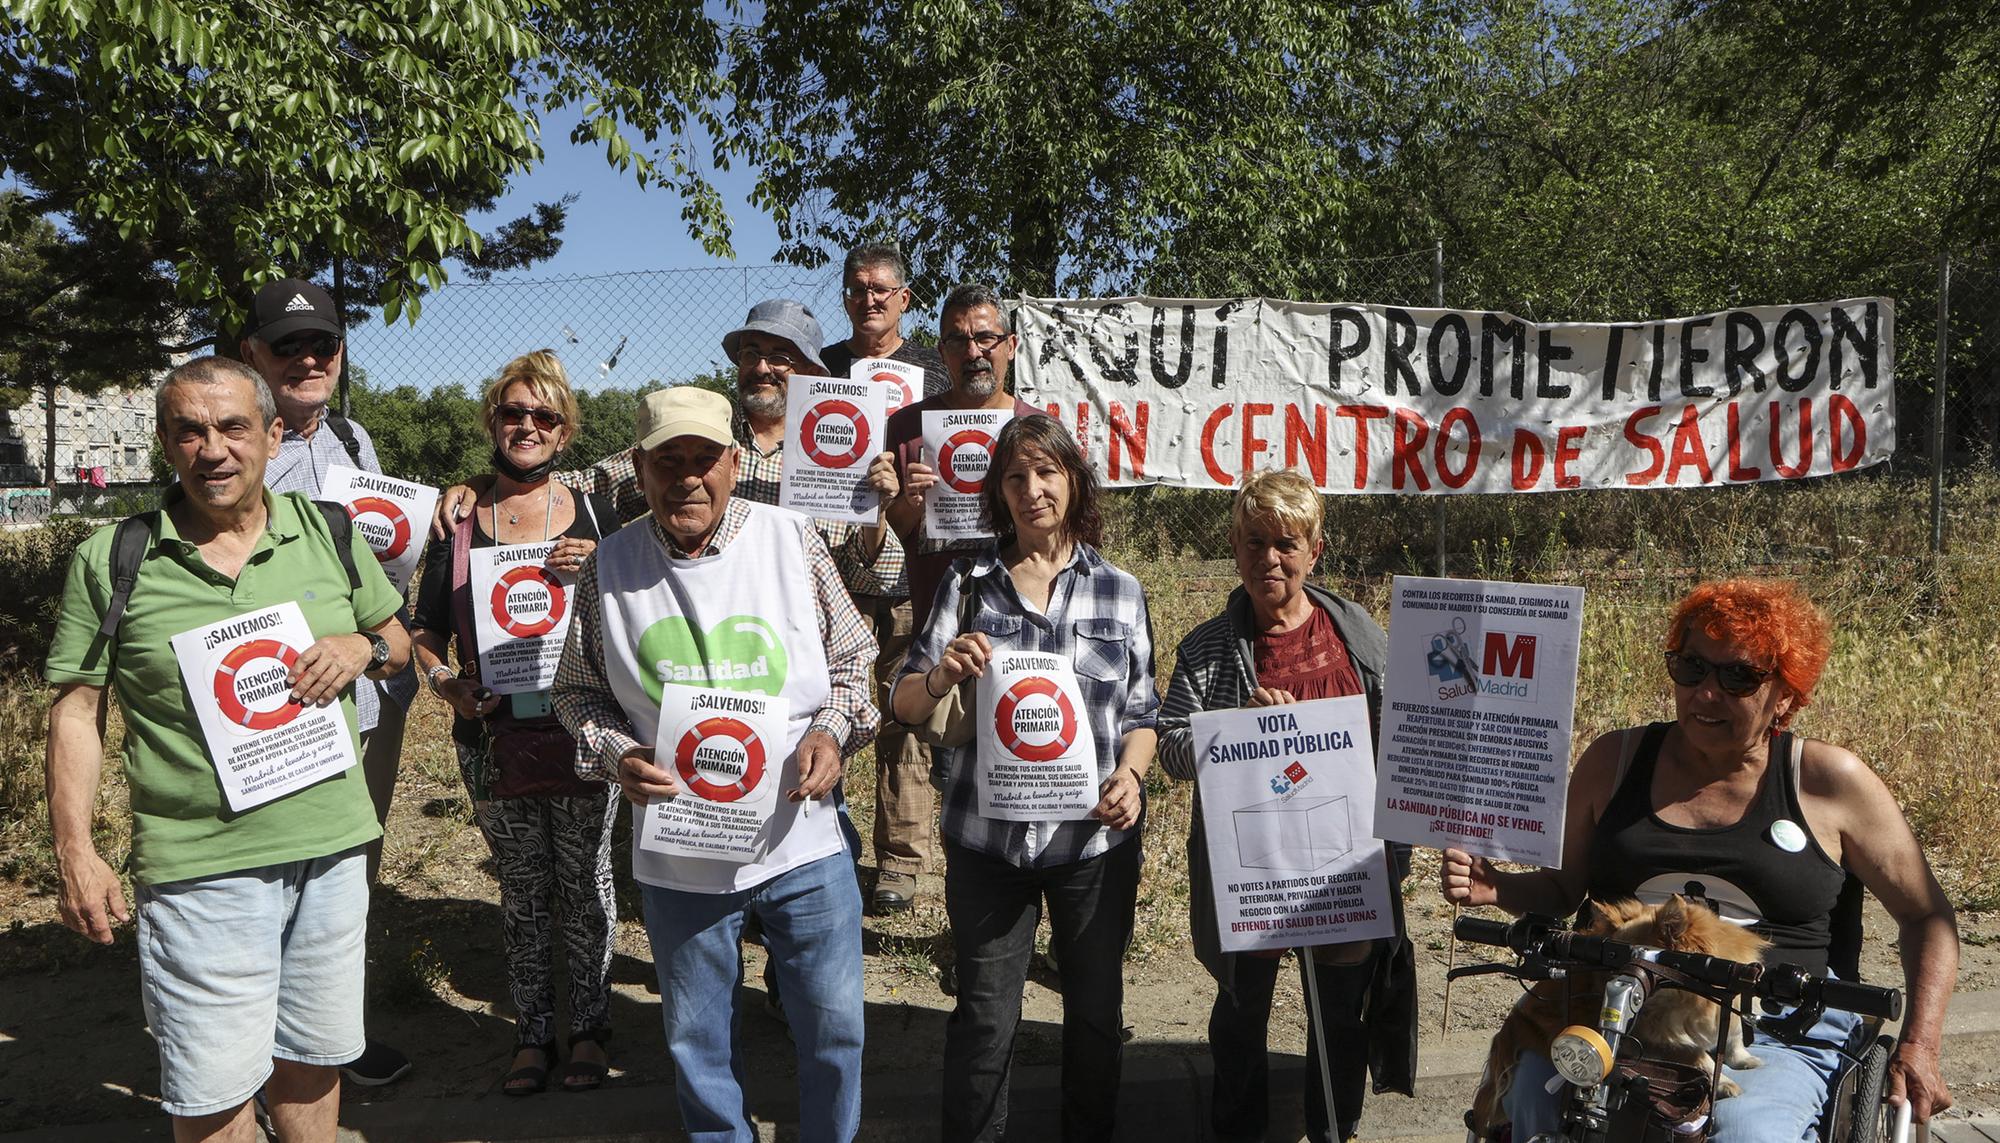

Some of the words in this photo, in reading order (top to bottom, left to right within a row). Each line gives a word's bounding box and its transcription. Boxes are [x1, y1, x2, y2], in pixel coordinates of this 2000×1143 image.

[285, 304, 315, 312] adidas
[1329, 302, 1878, 401] PROMETIERON
[809, 382, 868, 397] ¡¡SALVEMOS!!
[815, 423, 854, 435] ATENCIÓN
[943, 414, 998, 428] ¡¡SALVEMOS!!
[815, 434, 853, 446] PRIMARIA
[1200, 402, 1482, 492] CENTRO
[1511, 426, 1587, 491] DE
[1623, 394, 1866, 486] SALUD
[953, 450, 988, 463] ATENCIÓN
[953, 462, 989, 472] PRIMARIA
[350, 476, 417, 500] ¡¡SALVEMOS!!
[353, 520, 393, 538] TENCIÓN
[363, 534, 389, 548] MARIA
[507, 588, 548, 604] ATENCIÓN
[1403, 590, 1427, 599] CONTRA
[1428, 591, 1440, 600] LOS
[1442, 592, 1474, 602] RECORTES
[1475, 595, 1484, 603] EN
[1485, 595, 1517, 605] SANIDAD,
[1518, 598, 1552, 608] EXIGIMOS
[1554, 600, 1559, 608] A
[1560, 600, 1569, 609] LA
[508, 602, 549, 614] PRIMARIA
[1402, 601, 1438, 611] COMUNIDAD
[1439, 603, 1446, 611] DE
[1447, 604, 1472, 613] MADRID
[1478, 606, 1487, 614] SU
[1488, 606, 1527, 617] CONSEJERÍA
[1528, 609, 1537, 617] DE
[1538, 610, 1567, 620] SANIDAD
[204, 612, 283, 650] ¡¡SALVEMOS!!
[1482, 631, 1537, 680] M
[236, 665, 287, 692] ATENCIÓN
[656, 655, 769, 682] Sanidad
[240, 679, 290, 705] PRIMARIA
[690, 694, 766, 715] ¡¡SALVEMOS!!
[1015, 704, 1059, 720] ATENCIÓN
[1257, 713, 1298, 734] VOTA
[1393, 702, 1429, 714] REFUERZOS
[1430, 706, 1470, 719] SANITARIOS
[1472, 711, 1481, 720] EN
[1483, 712, 1519, 724] ATENCIÓN
[1521, 716, 1558, 729] PRIMARIA
[1407, 714, 1446, 726] REAPERTURA
[1447, 719, 1454, 727] DE
[1456, 720, 1474, 729] SUAP
[1475, 722, 1479, 730] Y
[1481, 723, 1495, 732] SAR
[1496, 724, 1511, 734] CON
[1014, 720, 1060, 733] PRIMARIA
[1398, 725, 1427, 735] ATENCIÓN
[1428, 728, 1465, 739] PRESENCIAL
[1466, 732, 1478, 741] SIN
[1479, 734, 1512, 745] DEMORAS
[1513, 738, 1548, 749] ABUSIVAS
[696, 747, 745, 763] ATENCIÓN
[1209, 739, 1280, 764] SANIDAD
[1284, 731, 1354, 756] PÚBLICA
[1392, 735, 1427, 746] ASIGNACIÓN
[1428, 739, 1435, 747] DE
[1512, 749, 1516, 757] Y
[1517, 750, 1552, 762] PEDIATRAS
[695, 759, 743, 776] PRIMARIA
[1402, 747, 1428, 757] ATENCIÓN
[1430, 750, 1457, 760] PRIMARIA
[1458, 754, 1468, 762] SIN
[1469, 755, 1500, 766] RECORTES
[1501, 759, 1509, 767] DE
[1510, 760, 1539, 771] HORARIO
[1399, 766, 1419, 775] DINERO
[1420, 769, 1444, 779] PÚBLICO
[1446, 772, 1460, 781] PARA
[1462, 774, 1489, 785] SANIDAD
[1490, 778, 1509, 788] 100%
[1511, 780, 1538, 792] PÚBLICA
[1404, 787, 1433, 798] RECUPERAR
[1434, 791, 1444, 800] LOS
[1445, 793, 1473, 804] CONSEJOS
[1474, 797, 1482, 805] DE
[1483, 799, 1502, 808] SALUD
[1504, 802, 1511, 810] DE
[1512, 803, 1529, 812] ZONA
[1388, 798, 1397, 809] LA
[1399, 800, 1437, 816] SANIDAD
[1439, 806, 1478, 822] PÚBLICA
[1480, 812, 1495, 824] NO
[1497, 815, 1509, 827] SE
[1511, 817, 1545, 832] VENDE,
[1430, 820, 1444, 834] ¡¡SE
[1446, 823, 1493, 839] DEFIENDE!!
[1228, 883, 1239, 893] NO
[1240, 881, 1263, 892] VOTES
[1265, 881, 1270, 889] A
[1272, 877, 1309, 889] PARTIDOS
[1310, 875, 1325, 886] QUE
[1327, 871, 1370, 884] RECORTAN,
[1240, 892, 1285, 904] DETERIORAN,
[1287, 888, 1328, 900] PRIVATIZAN
[1330, 888, 1335, 896] Y
[1336, 885, 1361, 895] HACEN
[1240, 906, 1271, 917] NEGOCIO
[1273, 905, 1288, 914] CON
[1290, 904, 1298, 913] LA
[1300, 901, 1331, 912] SANIDAD
[1333, 898, 1364, 909] PÚBLICA
[1232, 919, 1270, 932] DEFIENDE
[1272, 918, 1283, 929] TU
[1285, 916, 1313, 928] SALUD
[1315, 914, 1326, 925] EN
[1328, 913, 1344, 924] LAS
[1346, 910, 1376, 923] URNAS
